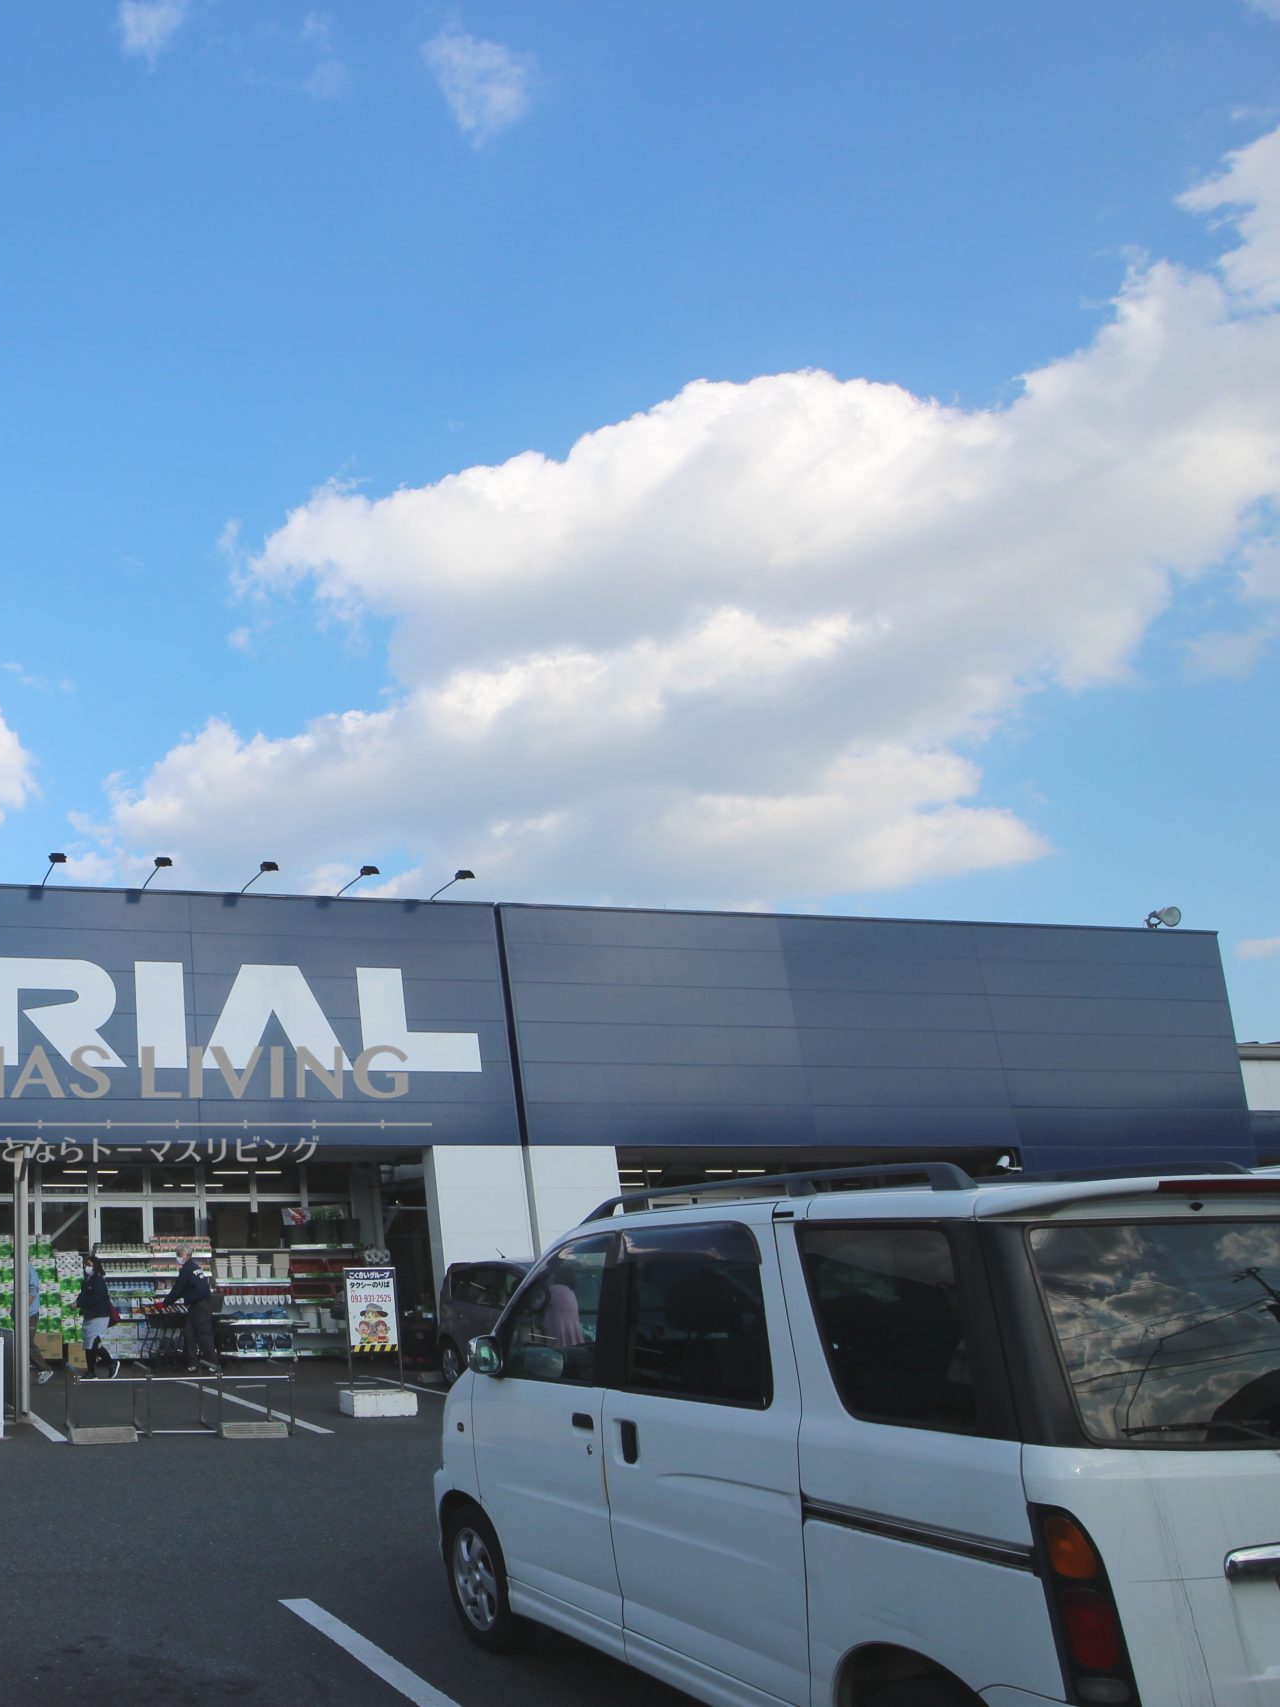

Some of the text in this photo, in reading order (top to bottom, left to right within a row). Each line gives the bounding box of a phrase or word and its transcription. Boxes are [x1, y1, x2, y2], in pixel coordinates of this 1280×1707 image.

[348, 1271, 390, 1279] こくさいグループ
[349, 1281, 391, 1289] タクシーのりば
